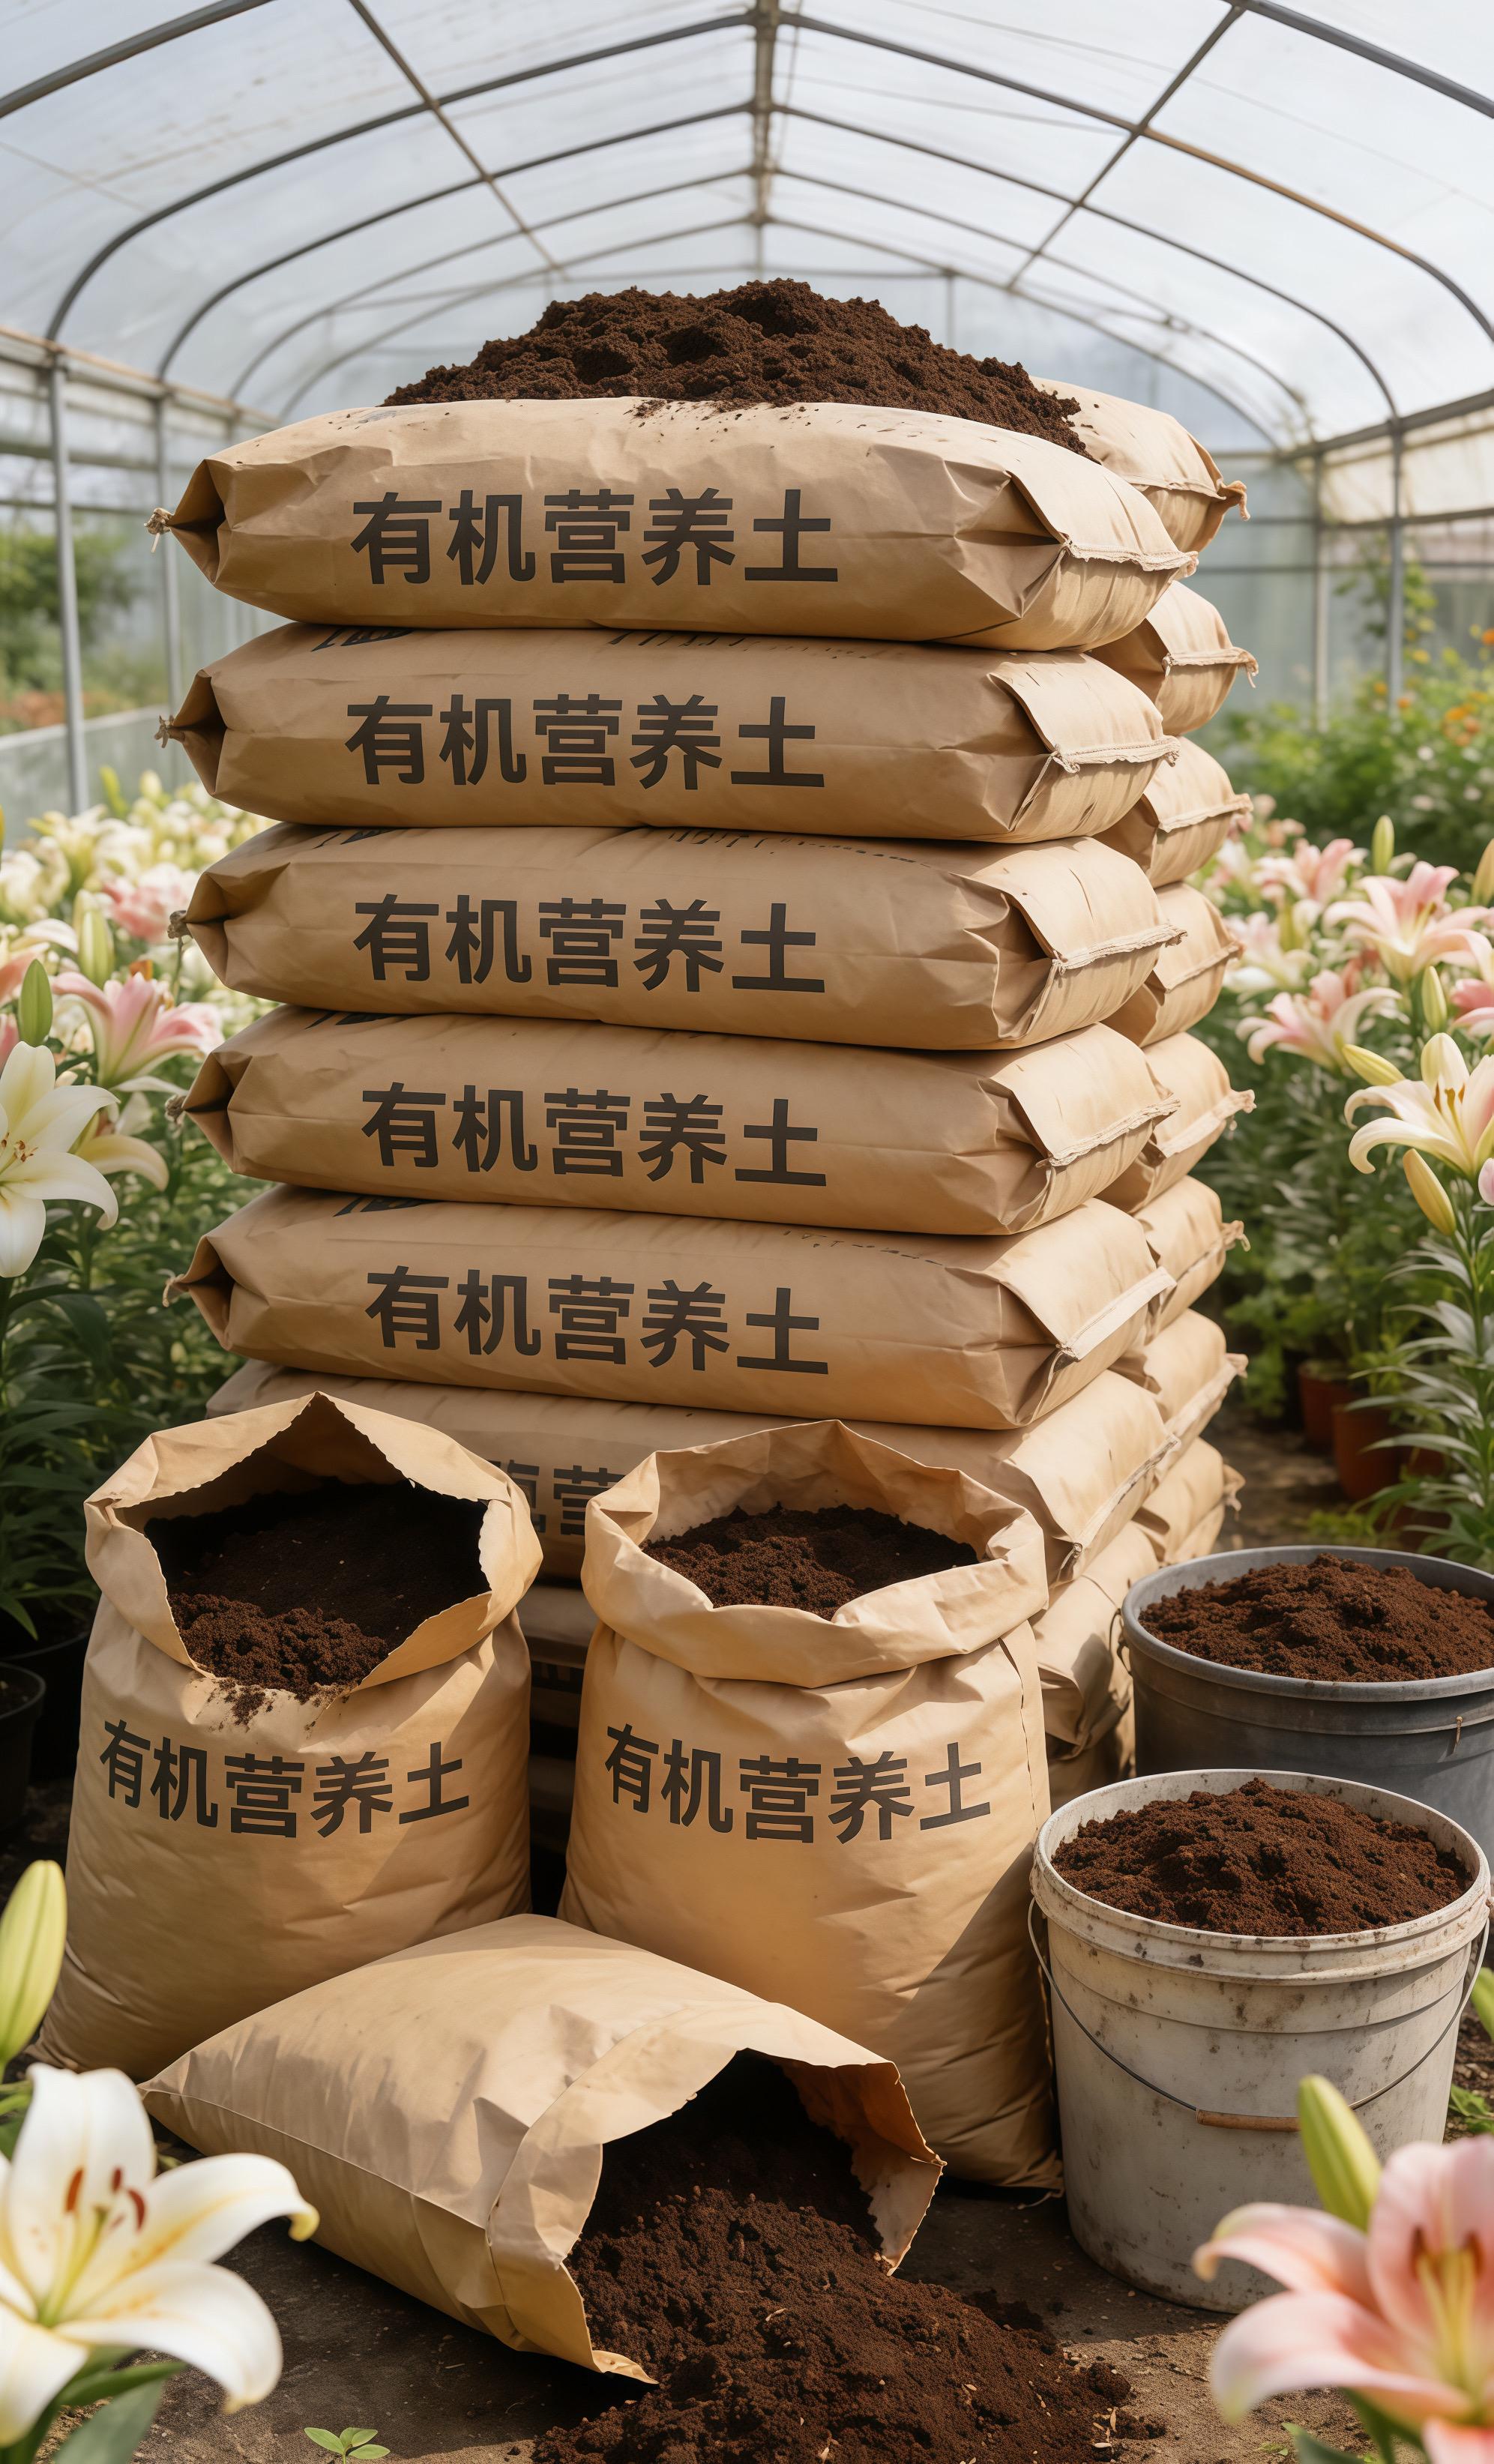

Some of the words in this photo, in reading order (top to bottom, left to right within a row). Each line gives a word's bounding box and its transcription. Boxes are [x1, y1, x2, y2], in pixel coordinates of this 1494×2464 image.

[350, 488, 838, 585] 有机营养土
[344, 694, 825, 790] 有机营养土
[353, 894, 825, 993] 有机营养土
[361, 1082, 826, 1187] 有机营养土
[365, 1265, 828, 1375] 有机营养土
[100, 1720, 469, 1838] 有机营养土
[605, 1723, 991, 1845] 有机营养土
